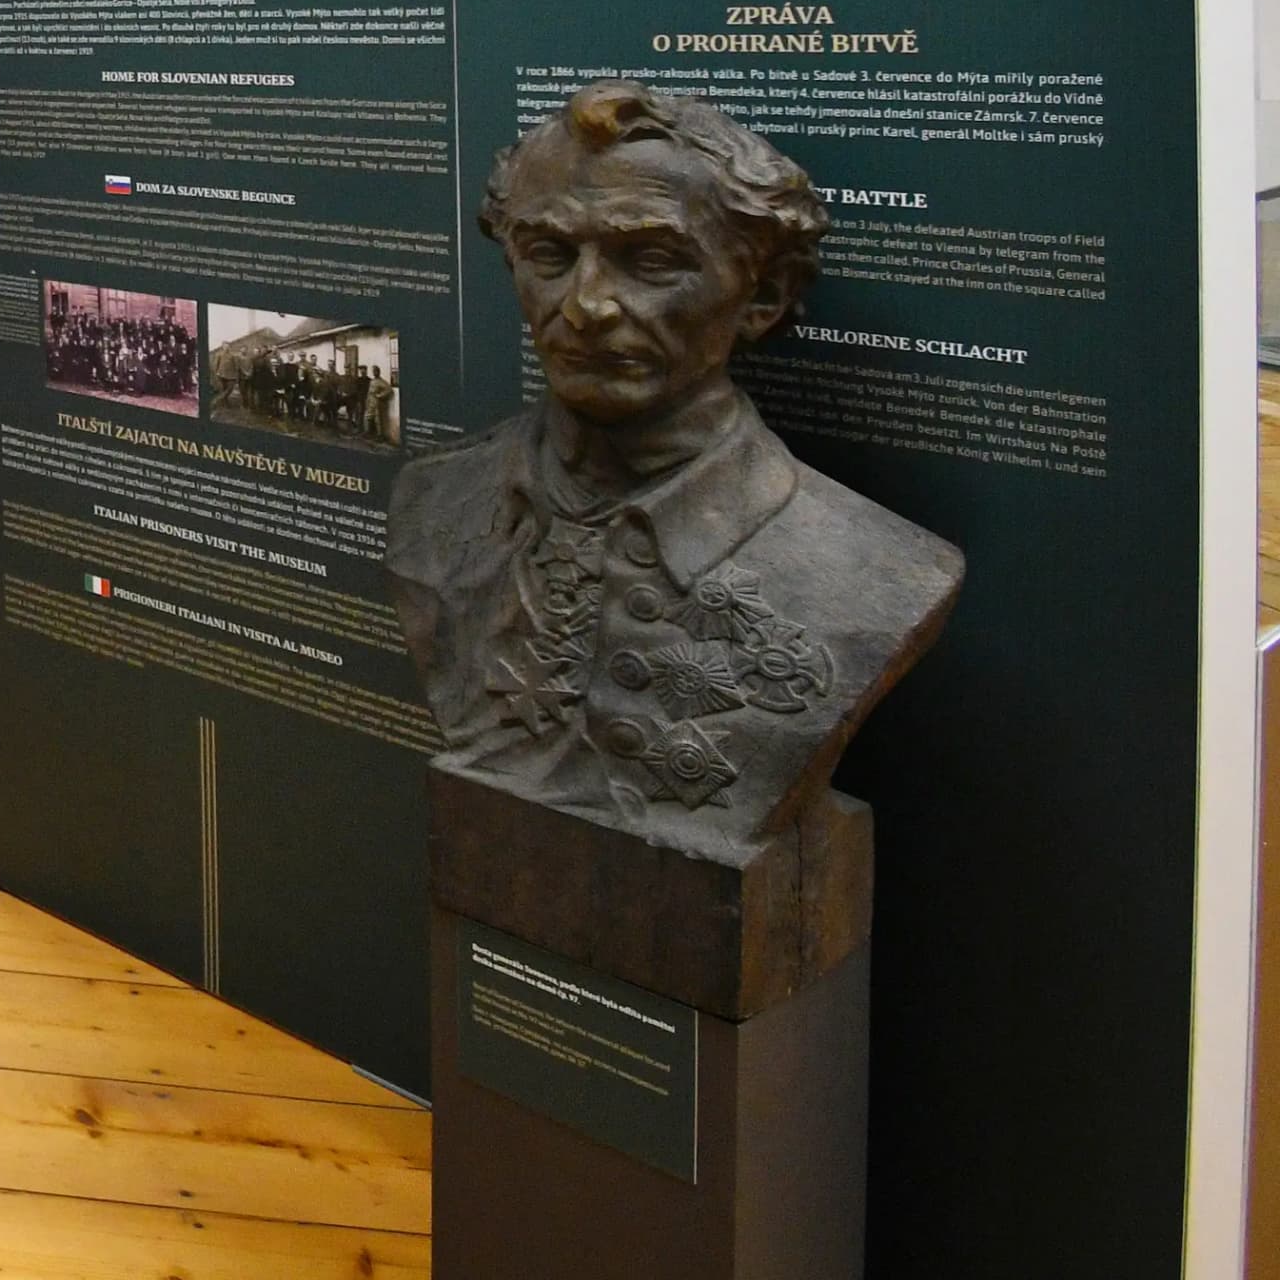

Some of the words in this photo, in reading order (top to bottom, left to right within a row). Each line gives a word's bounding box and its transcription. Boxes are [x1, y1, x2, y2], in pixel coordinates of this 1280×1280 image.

[727, 2, 834, 23] ZPRÁVA
[653, 35, 670, 51] O
[677, 30, 824, 52] PROHRANÉ
[831, 30, 918, 53] BITVĚ
[102, 72, 135, 82] HOME
[137, 72, 159, 82] FOR
[161, 73, 227, 84] SLOVENIAN
[231, 74, 294, 86] REFUGEES
[876, 71, 932, 82] července
[937, 72, 952, 82] do
[958, 72, 989, 85] Mýta
[1039, 74, 1103, 86] poražené
[137, 183, 160, 193] DOM
[162, 185, 176, 194] ZA
[178, 186, 240, 200] SLOVENSKE
[242, 191, 295, 205] BEGUNCE
[842, 189, 927, 208] BATTLE
[1019, 232, 1057, 245] troops
[1060, 234, 1072, 244] of
[1075, 235, 1104, 246] Field
[796, 326, 911, 350] VERLORENE
[916, 339, 1027, 364] SCHLACHT
[983, 399, 1005, 410] Von
[1009, 402, 1028, 413] der
[1033, 405, 1106, 424] Bahnstation
[59, 413, 111, 436] ITALŠTÍ
[116, 426, 173, 450] ZAJATCI
[178, 439, 199, 456] NA
[203, 445, 287, 475] NÁVŠTĚVĚ
[290, 464, 302, 478] V
[306, 467, 369, 493] MUZEU
[94, 505, 137, 525] ITALIAN
[140, 517, 203, 543] PRISONERS
[205, 535, 237, 552] VISIT
[240, 544, 266, 560] THE
[269, 552, 326, 576] MUSEUM
[114, 587, 176, 614] PRIGIONIERI
[179, 607, 225, 630] ITALIANI
[228, 623, 241, 634] IN
[243, 627, 281, 647] VISITA
[283, 640, 298, 652] AL
[300, 644, 342, 665] MUSEO
